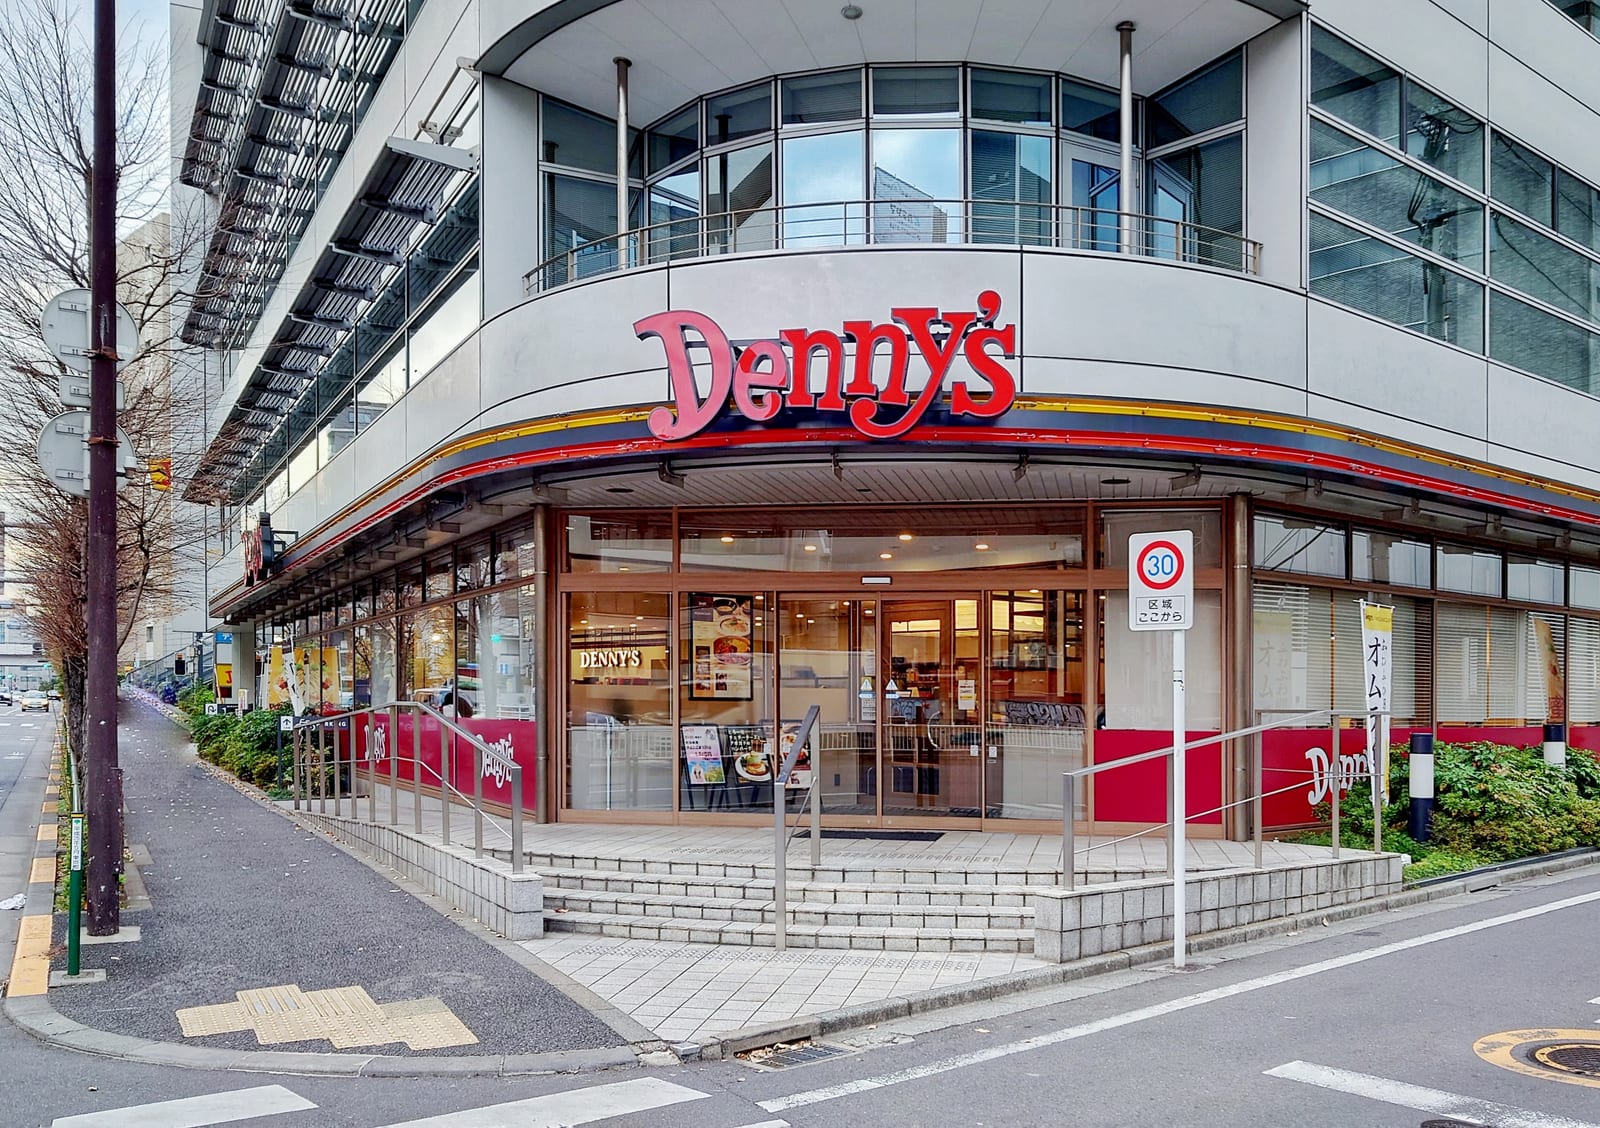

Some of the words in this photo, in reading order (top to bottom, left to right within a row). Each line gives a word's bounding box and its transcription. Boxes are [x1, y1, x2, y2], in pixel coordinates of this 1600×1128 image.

[633, 289, 1016, 441] Denny's
[1147, 554, 1174, 577] 30
[1148, 599, 1173, 610] 区域
[1138, 611, 1183, 623] ここから
[580, 650, 640, 668] DENNY'S
